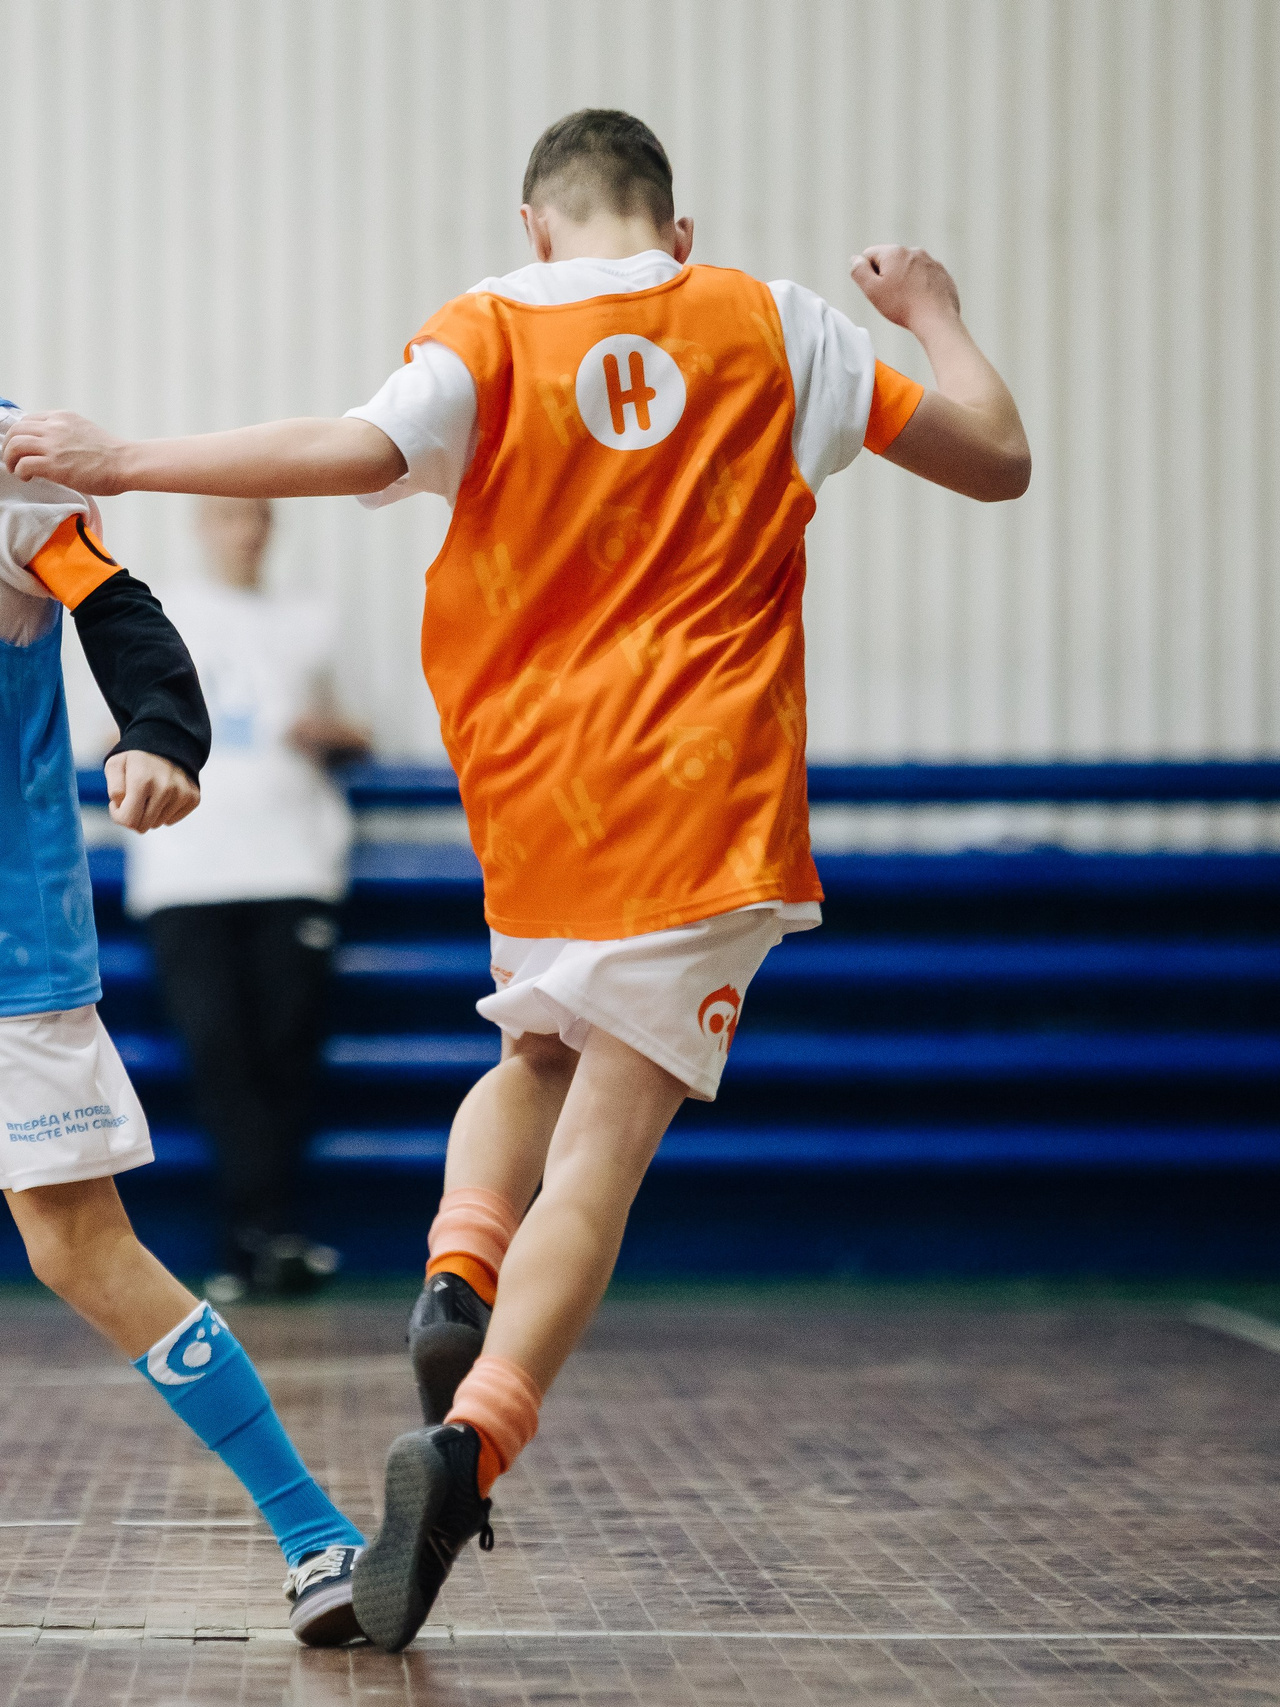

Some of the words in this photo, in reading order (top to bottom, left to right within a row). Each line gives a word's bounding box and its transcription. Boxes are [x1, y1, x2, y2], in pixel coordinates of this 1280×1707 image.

[6, 1114, 60, 1132] ВПЕРЁД
[62, 1111, 72, 1122] К
[9, 1127, 63, 1143] ВМЕСТЕ
[65, 1122, 89, 1135] МЫ
